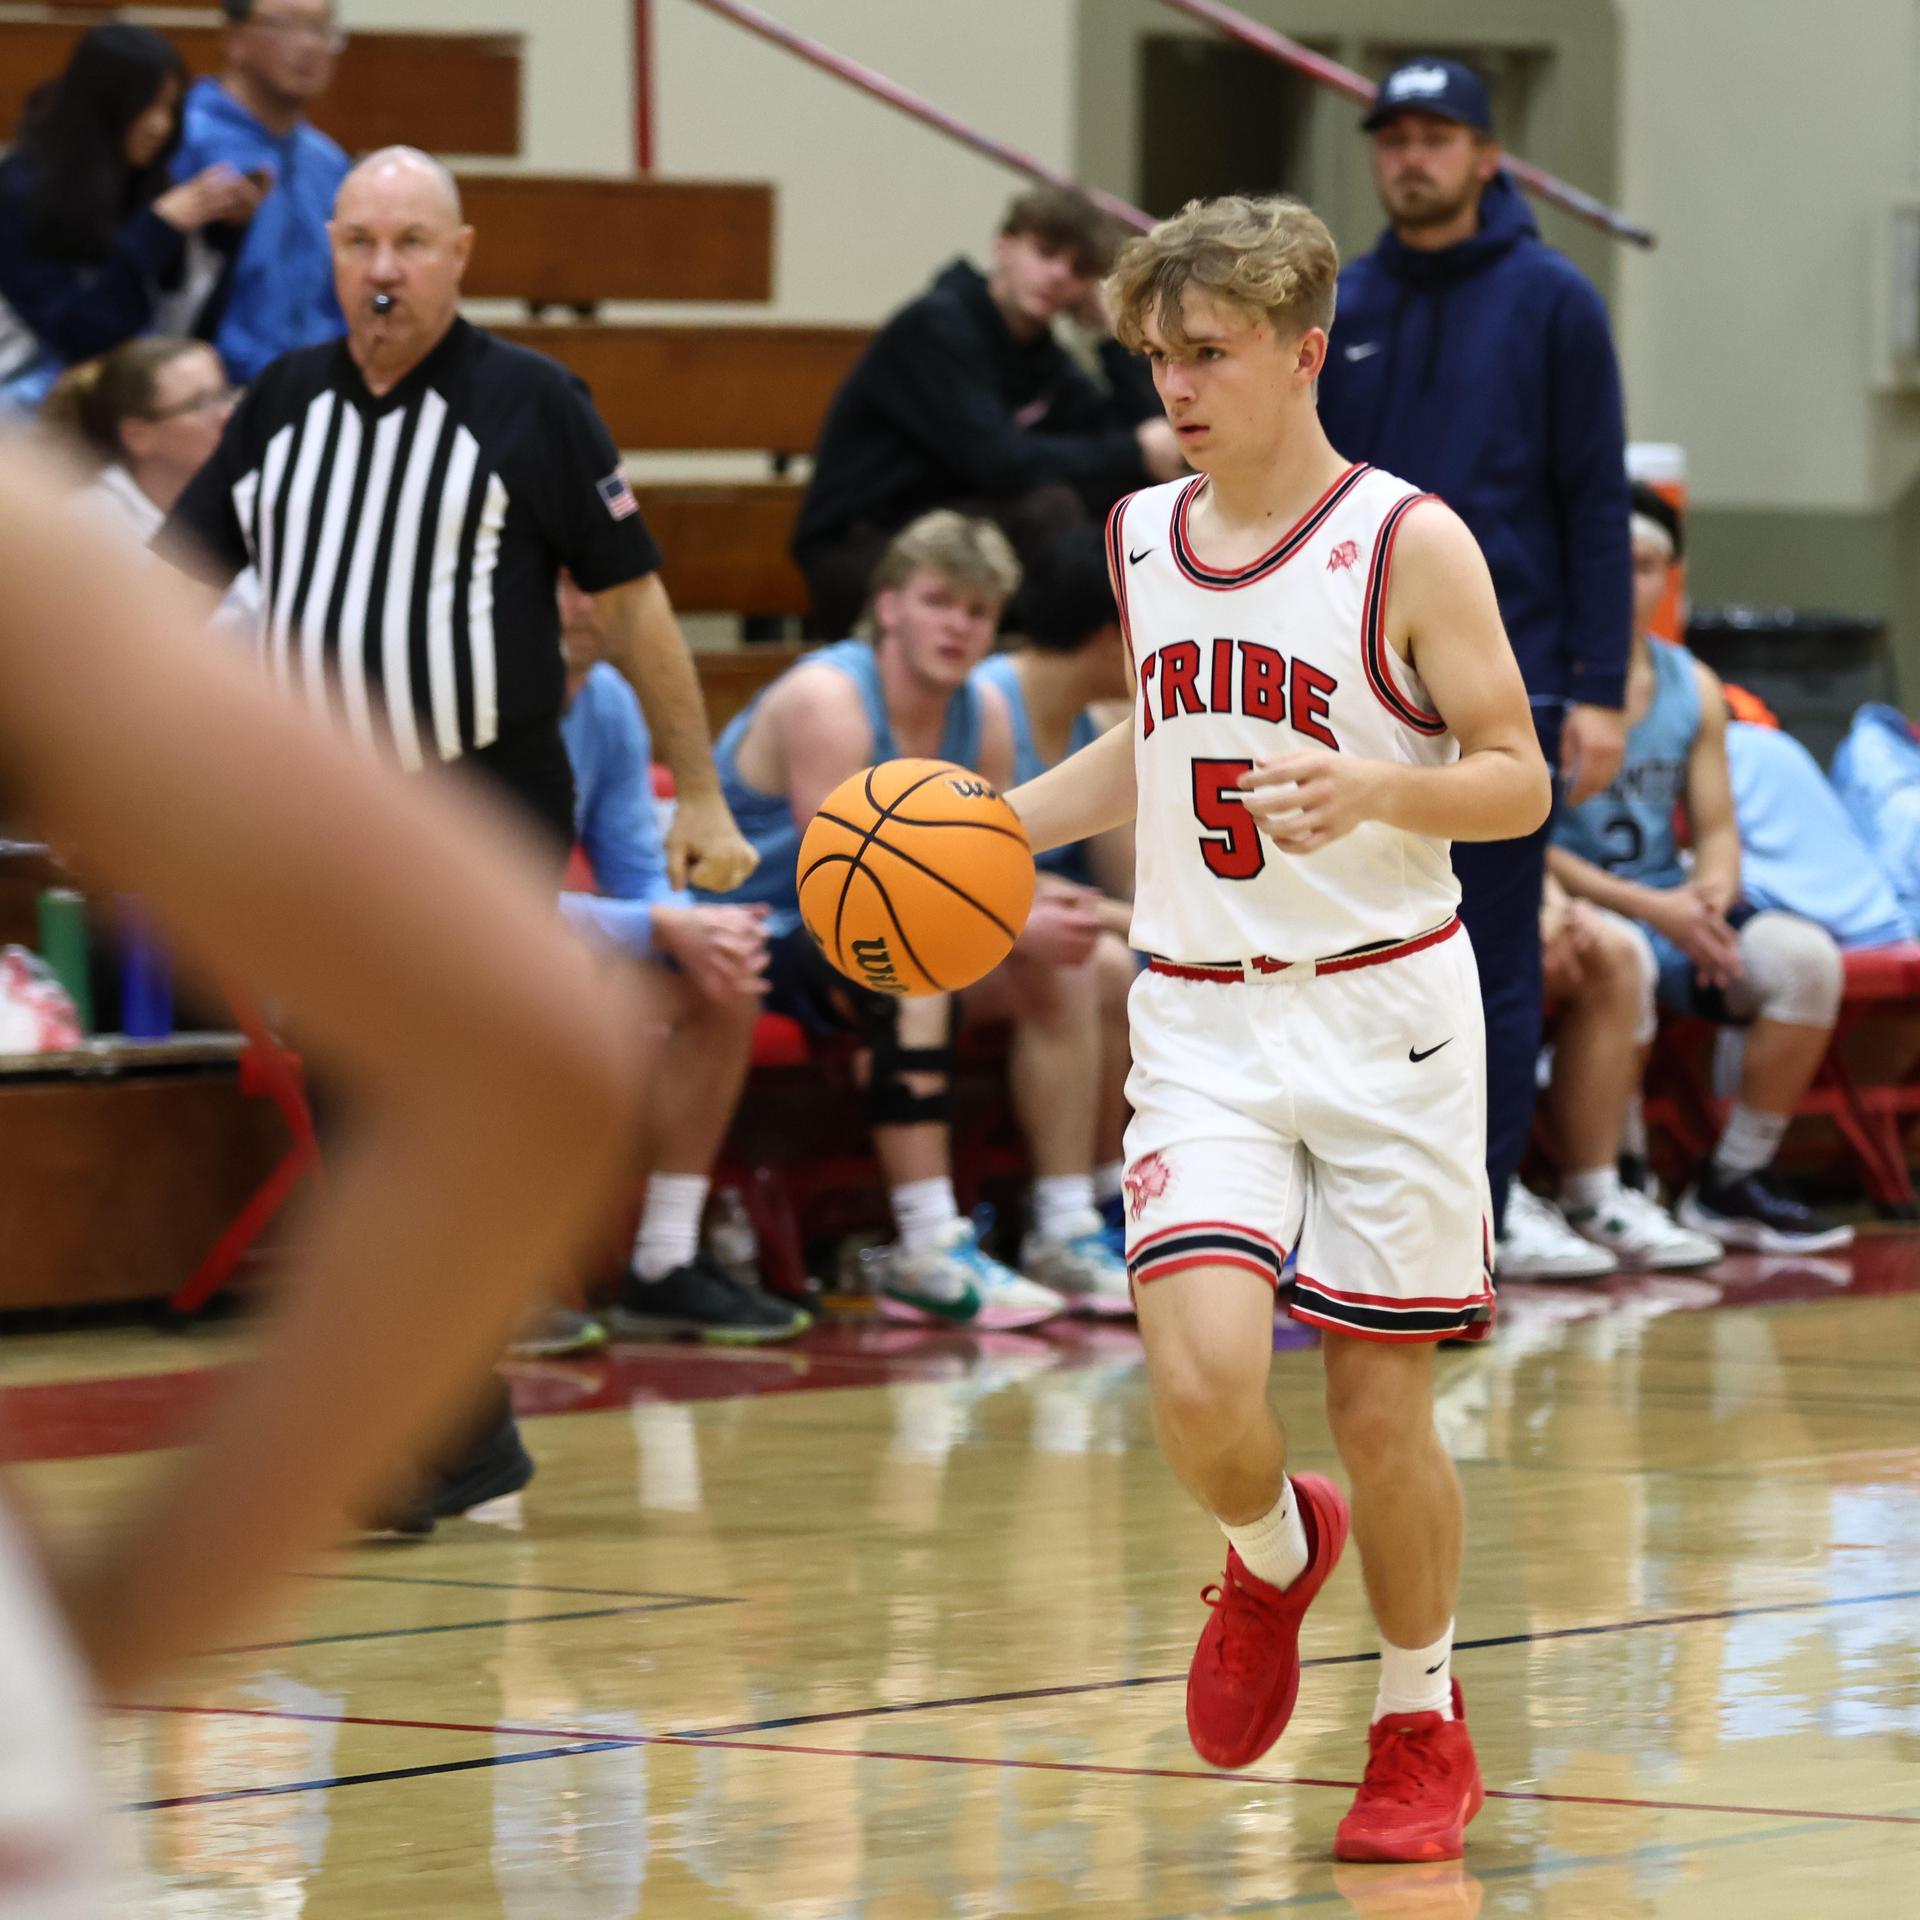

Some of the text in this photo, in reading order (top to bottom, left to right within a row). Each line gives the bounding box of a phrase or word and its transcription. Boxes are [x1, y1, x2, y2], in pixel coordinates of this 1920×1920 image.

[1140, 638, 1340, 752] TRIBE
[1191, 757, 1266, 881] 5
[1603, 817, 1642, 870] 2
